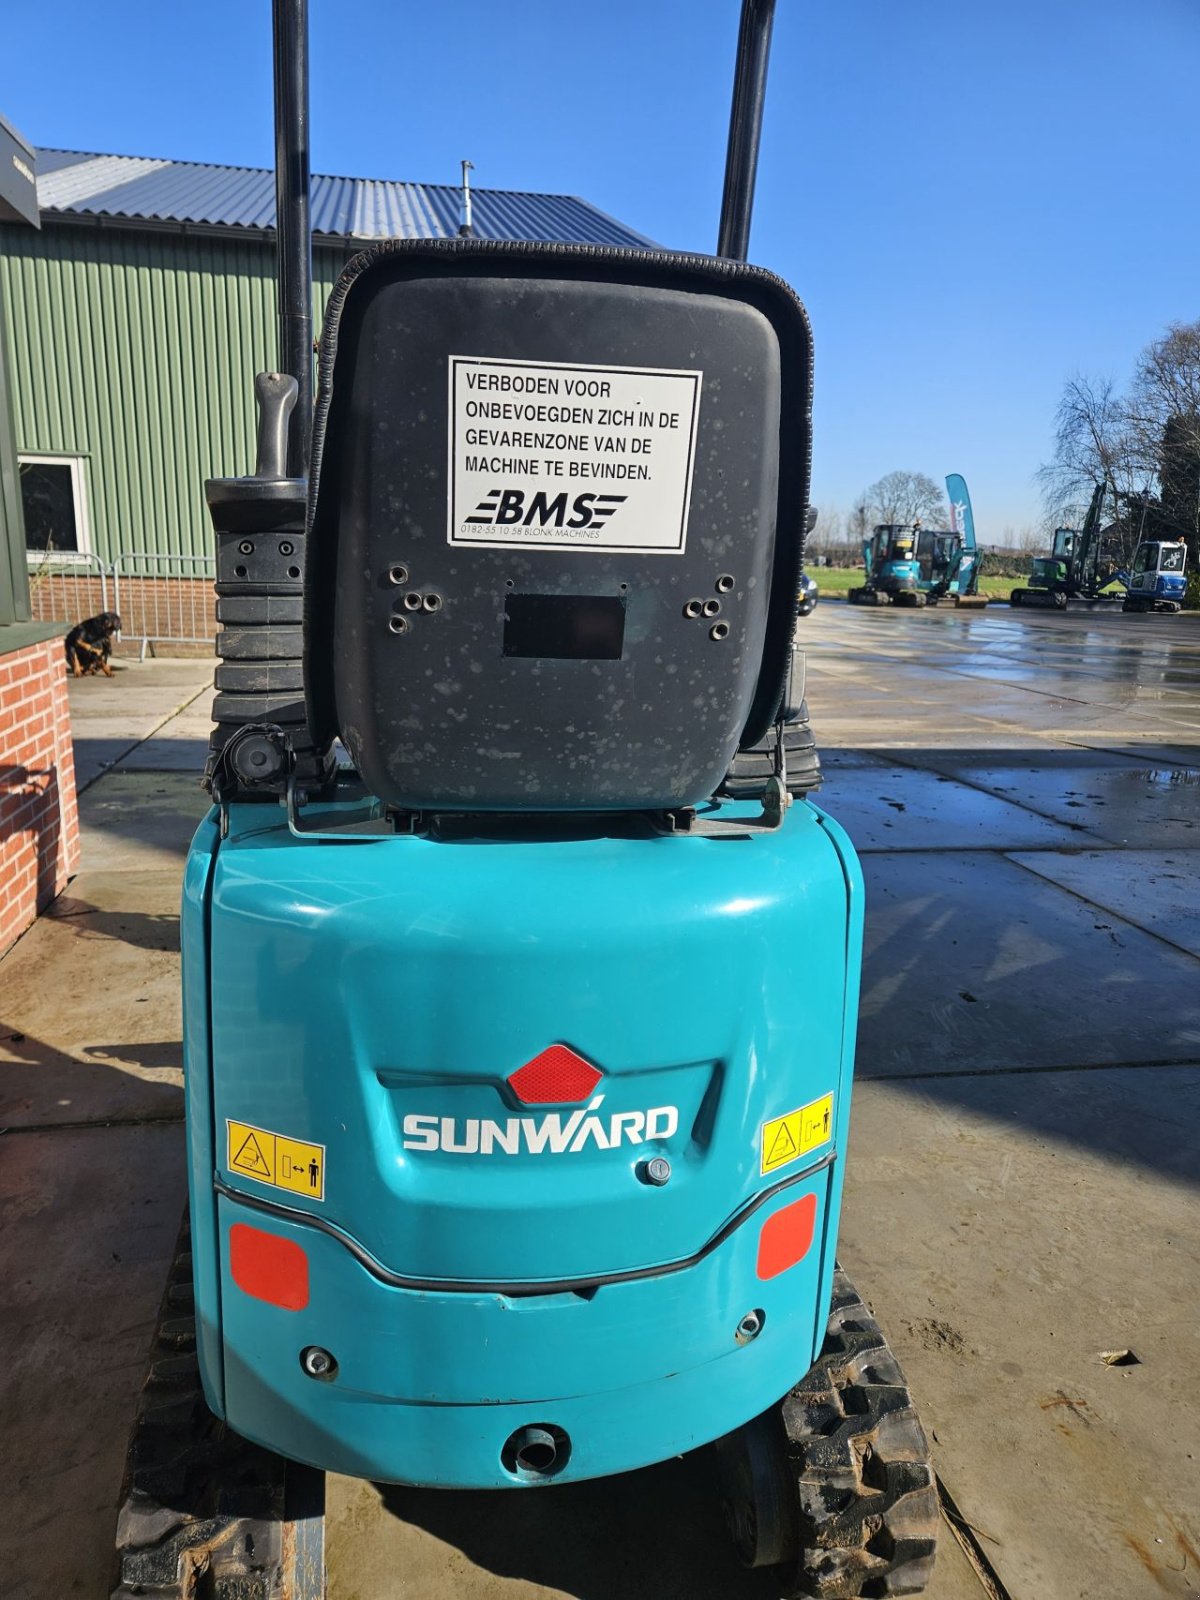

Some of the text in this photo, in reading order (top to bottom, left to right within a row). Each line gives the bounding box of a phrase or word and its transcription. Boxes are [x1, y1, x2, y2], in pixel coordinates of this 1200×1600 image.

[466, 372, 611, 398] VERBODEN VOOR
[465, 401, 680, 429] ONBEVOEGDEN ZICH IN DE
[465, 429, 652, 454] GEVARENZONE VAN DE
[465, 456, 652, 480] MACHINE TE BEVINDEN.
[494, 489, 599, 529] BMS
[460, 524, 600, 539] 0182-55 10 58 BLONK MACHINES
[403, 1094, 679, 1154] SUNWARD
